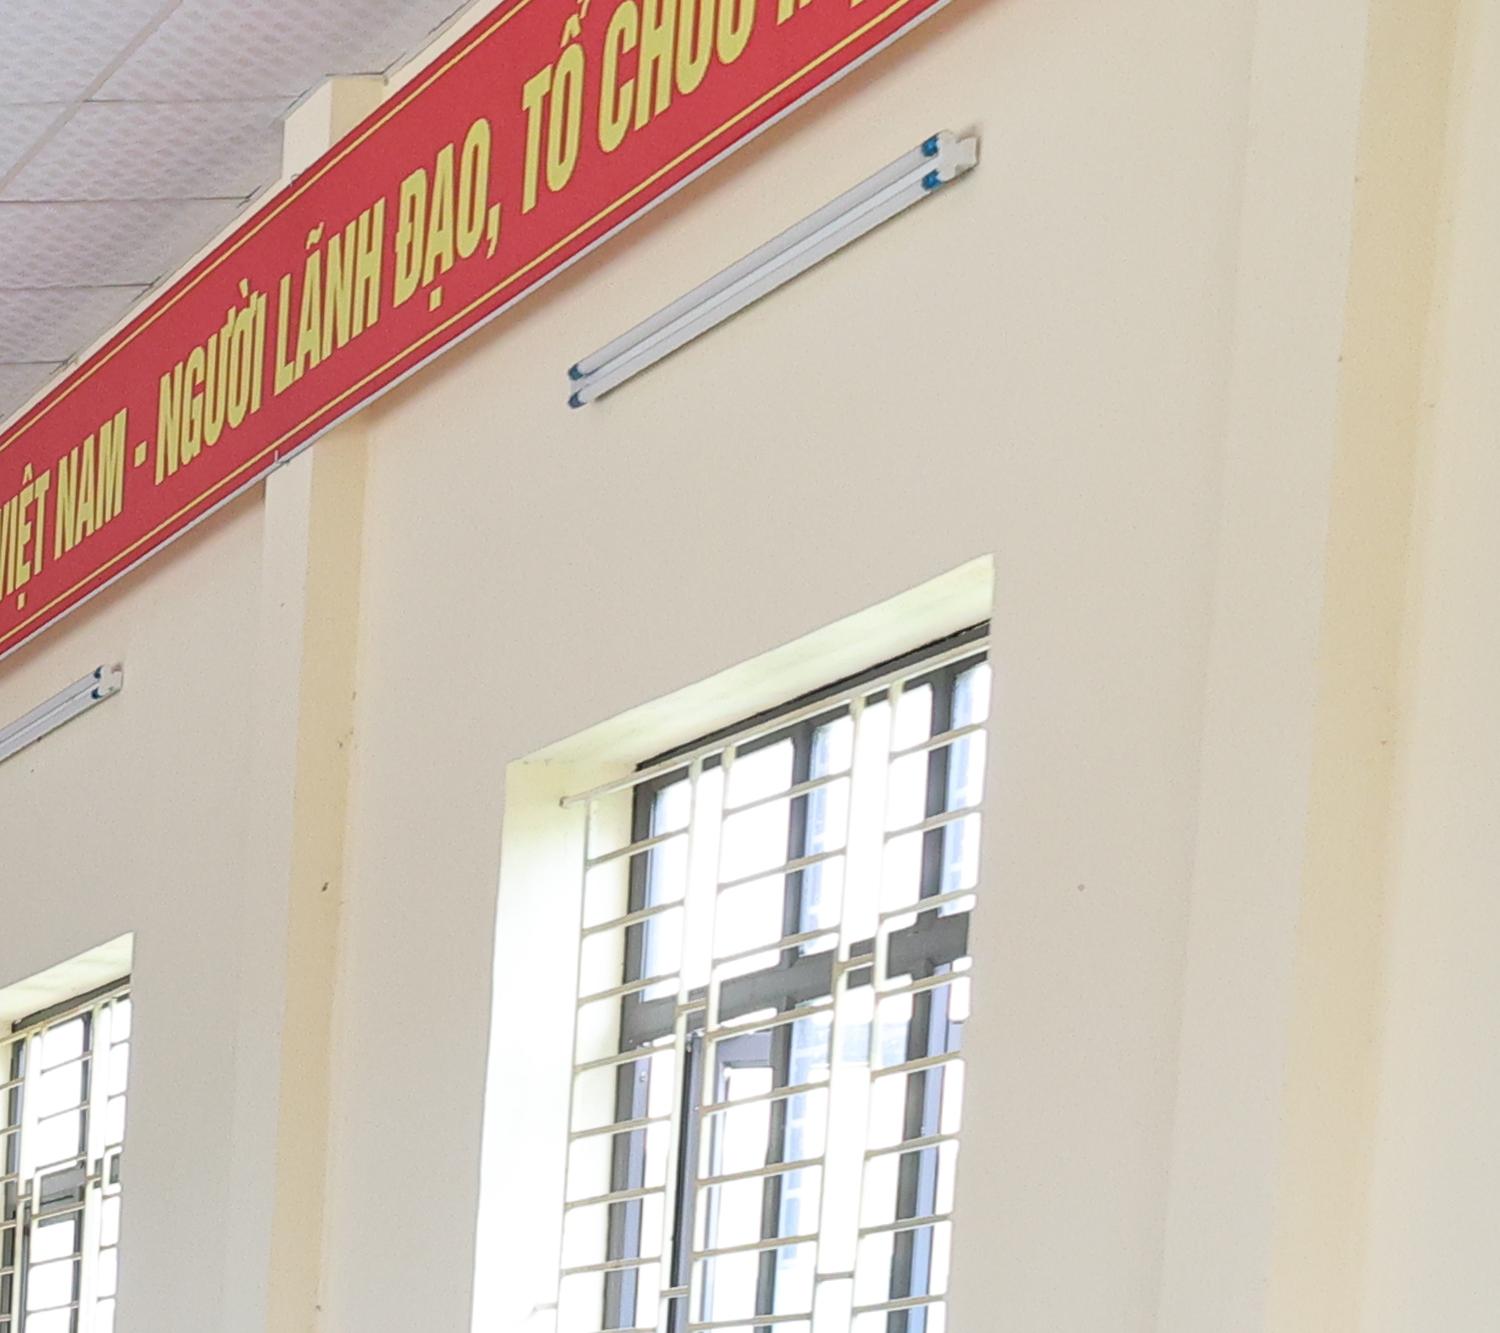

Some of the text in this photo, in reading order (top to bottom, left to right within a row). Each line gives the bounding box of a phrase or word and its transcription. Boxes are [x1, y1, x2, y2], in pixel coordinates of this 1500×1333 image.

[53, 407, 127, 560] NAM
[155, 278, 267, 485] NGƯỜI
[274, 199, 387, 397] LÃNH
[393, 117, 502, 311] ĐẠO,
